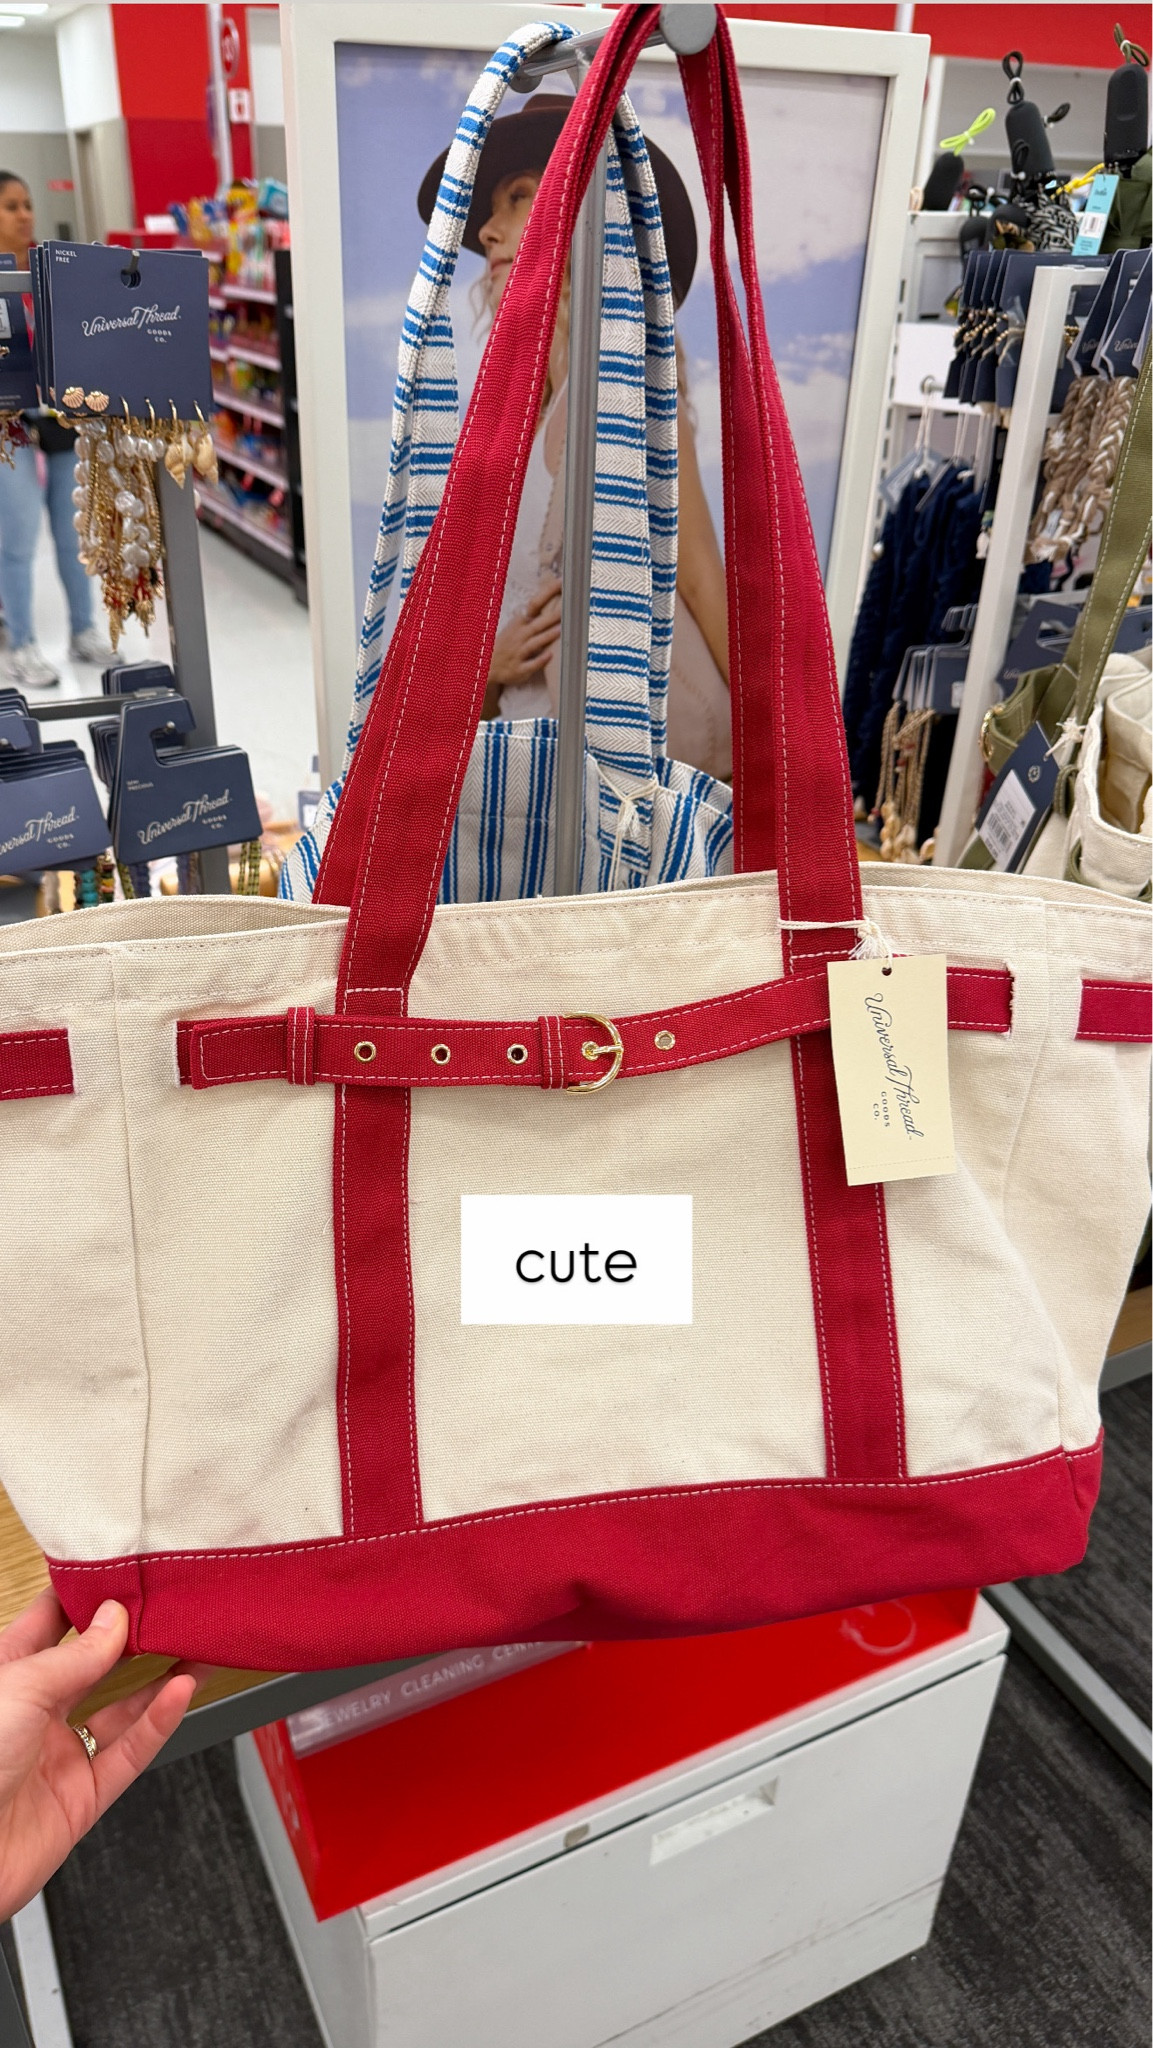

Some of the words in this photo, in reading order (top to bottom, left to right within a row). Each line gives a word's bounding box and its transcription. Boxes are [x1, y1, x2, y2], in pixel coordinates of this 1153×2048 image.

[55, 249, 77, 257] NICKEL
[55, 256, 70, 264] FREE
[81, 310, 139, 337] Universal
[131, 303, 181, 329] Thread
[24, 805, 77, 842] Thread
[137, 805, 192, 845] Universal
[182, 788, 231, 823] Thread
[864, 993, 908, 1077] Universal
[881, 1091, 891, 1128] GOODS
[884, 1065, 925, 1138] Thread
[401, 1653, 485, 1697] CLEANING
